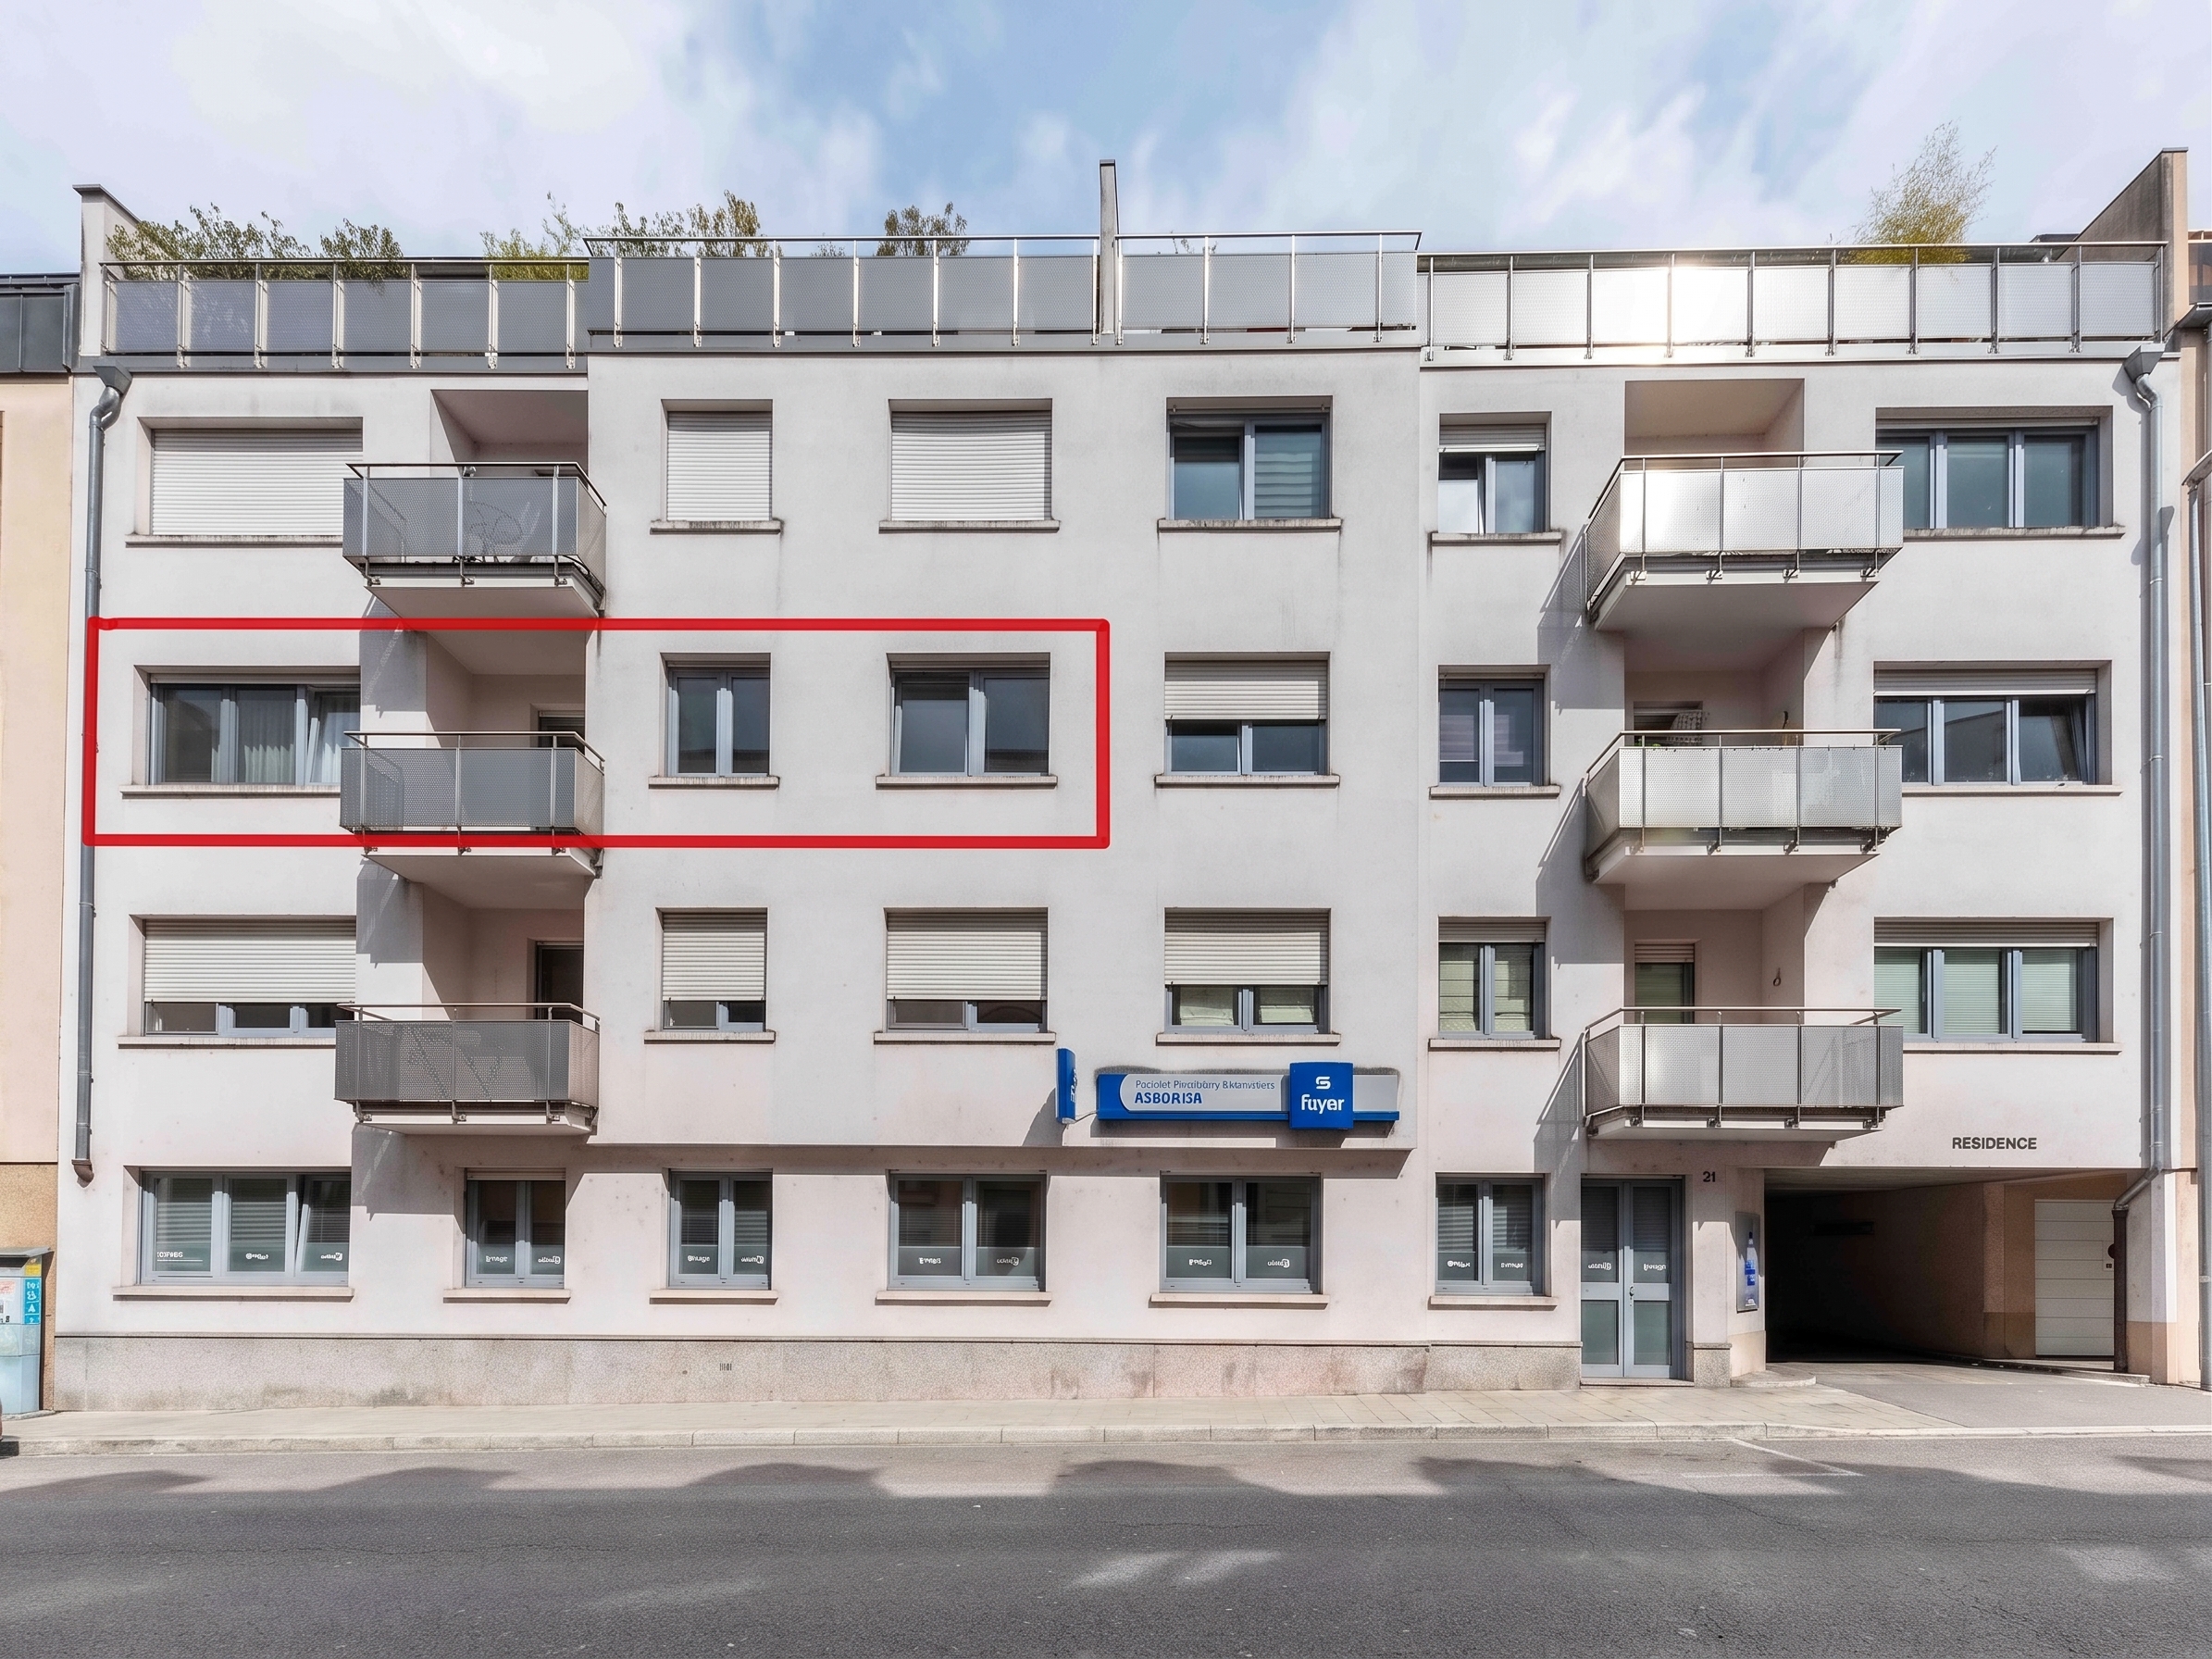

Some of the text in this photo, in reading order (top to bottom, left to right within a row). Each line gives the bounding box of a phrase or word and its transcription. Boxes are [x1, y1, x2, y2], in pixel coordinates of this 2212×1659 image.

[1301, 1093, 1345, 1115] fuyer
[1952, 1137, 2037, 1150] RESIDENCE
[1702, 1171, 1717, 1183] 21
